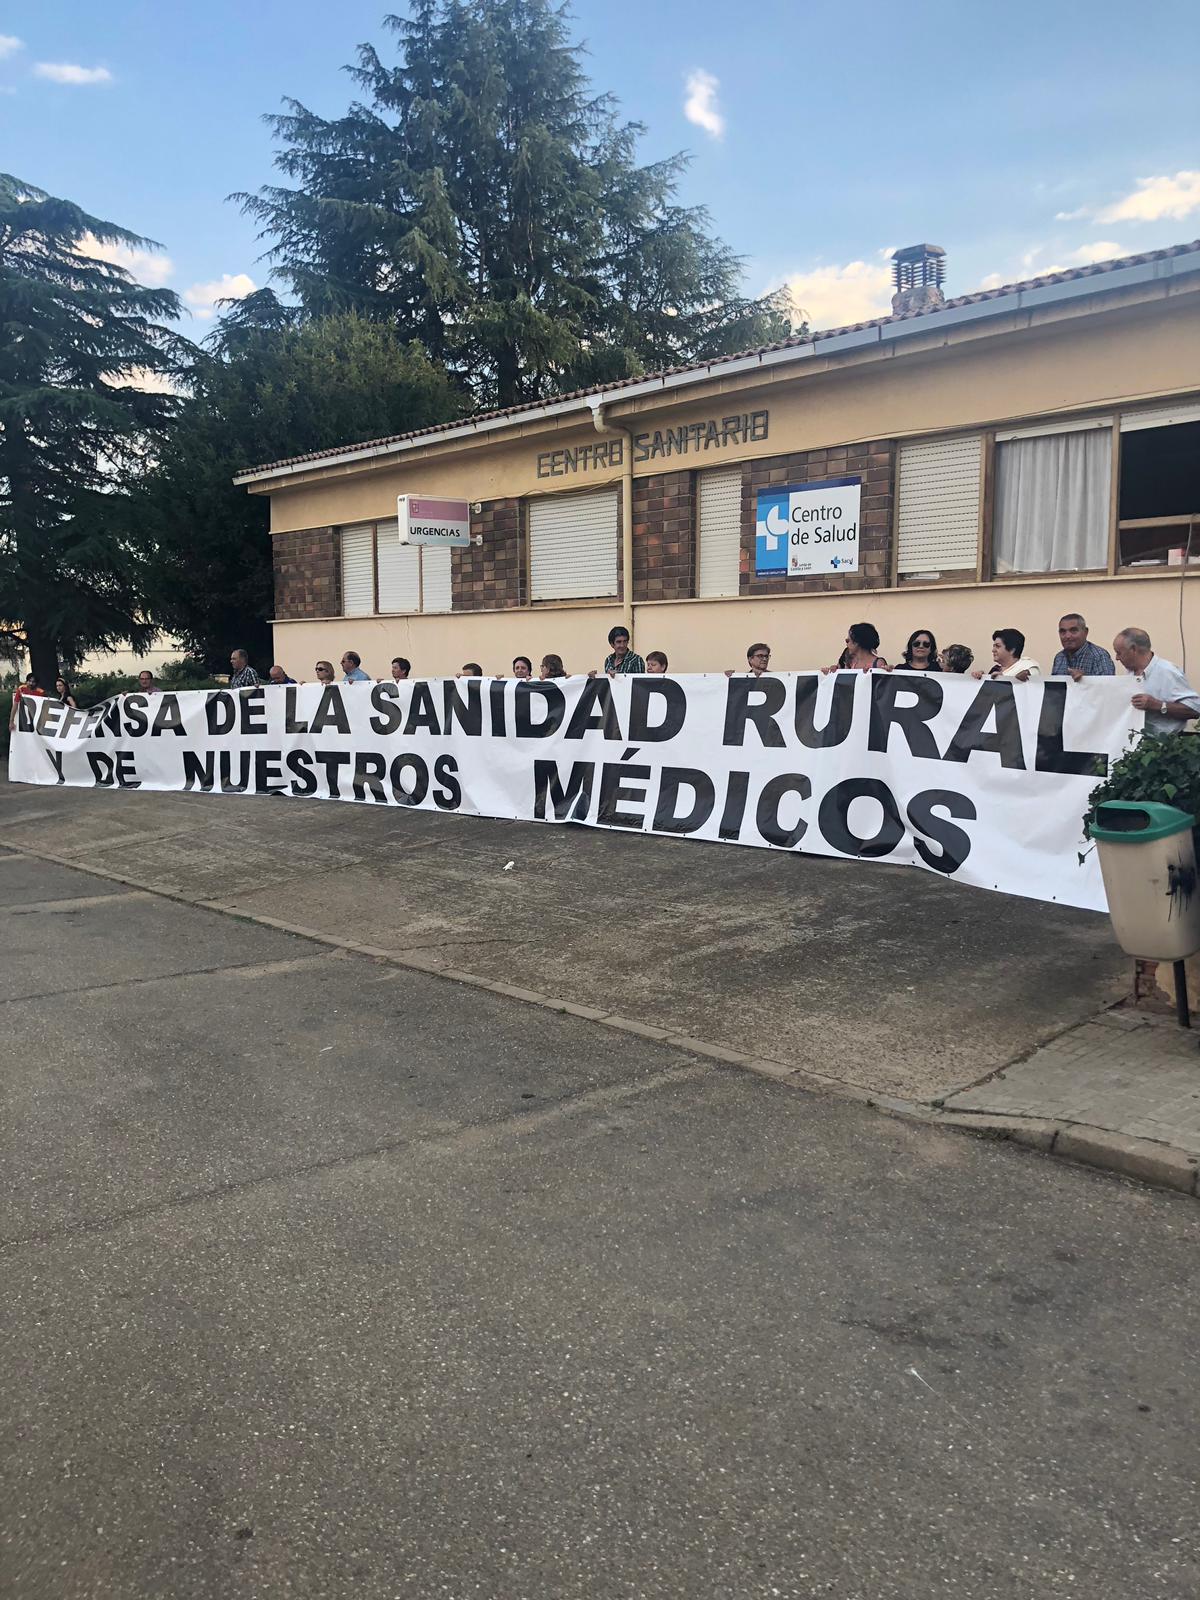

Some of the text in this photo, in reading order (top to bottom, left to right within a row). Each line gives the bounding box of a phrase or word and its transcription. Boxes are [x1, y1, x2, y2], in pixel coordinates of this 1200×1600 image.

[536, 409, 769, 479] CENTRO SANITARIO
[409, 526, 461, 537] URGENCIAS
[791, 505, 842, 523] Centro
[791, 522, 857, 545] de Salud
[18, 673, 1108, 778] DEFENSA DE LA SANIDAD RURAL
[87, 751, 142, 789] DE
[183, 749, 461, 810] NUESTROS
[533, 747, 977, 874] MÉDICOS
